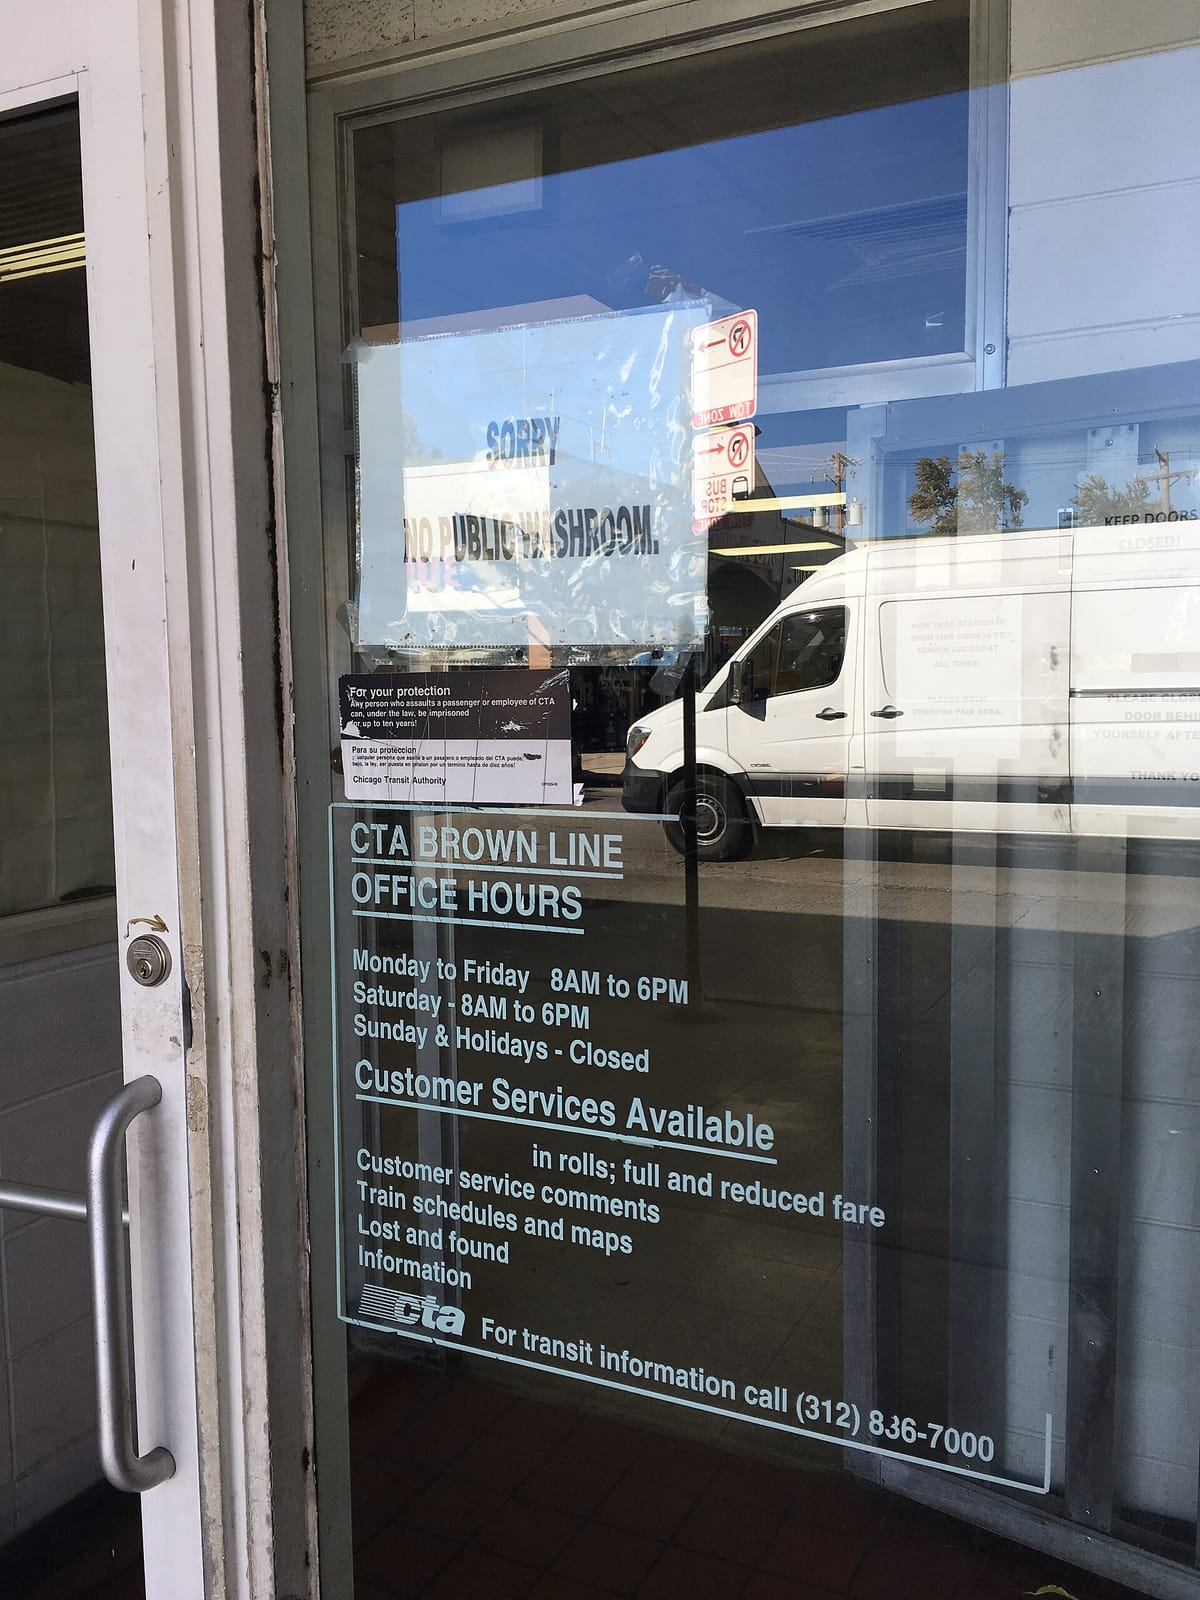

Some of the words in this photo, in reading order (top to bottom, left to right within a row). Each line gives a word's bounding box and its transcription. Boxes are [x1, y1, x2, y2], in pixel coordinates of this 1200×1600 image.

[486, 416, 561, 468] SORRY
[403, 518, 433, 563] NO
[439, 513, 515, 562] PUBLIC
[518, 504, 660, 561] WASHROOM.
[1104, 513, 1140, 526] KEEP
[1144, 508, 1198, 524] DOORS
[1118, 535, 1182, 551] CLOSED!
[350, 687, 367, 697] For
[370, 688, 394, 699] your
[397, 685, 451, 699] protection
[365, 701, 389, 709] person
[406, 699, 436, 707] assaults
[443, 700, 480, 708] passenger
[491, 698, 528, 707] employee
[529, 697, 537, 706] of
[538, 697, 556, 706] CTA
[402, 709, 416, 718] law,
[418, 709, 427, 717] be
[429, 709, 470, 718] imprisoned
[1161, 692, 1200, 703] CLOS
[396, 719, 418, 729] years!
[1124, 711, 1161, 721] DOOR
[1165, 711, 1200, 721] BEHI
[1166, 730, 1200, 741] AFTE
[352, 746, 367, 754] Para
[352, 775, 382, 785] Chicago
[384, 775, 410, 784] Transit
[412, 776, 447, 786] Authority
[1129, 770, 1177, 781] THANK
[1181, 772, 1200, 782] YO
[351, 822, 410, 857] CTA
[418, 826, 537, 864] BROWN
[549, 832, 624, 869] LINE
[352, 872, 458, 911] OFFICE
[468, 879, 583, 920] HOURS
[353, 949, 431, 983] Monday
[437, 961, 457, 980] to
[463, 959, 530, 994] Friday
[550, 967, 601, 996] 8AM
[607, 974, 630, 998] to
[637, 976, 689, 1005] 6PM
[353, 981, 442, 1018] Saturday
[461, 993, 507, 1021] 8AM
[513, 999, 536, 1025] to
[541, 1002, 590, 1030] 6PM
[353, 1013, 429, 1050] Sunday
[434, 1023, 450, 1048] &
[456, 1026, 548, 1064] Holidays
[568, 1039, 650, 1074] Closed
[354, 1058, 484, 1106] Customer
[491, 1077, 617, 1127] Services
[625, 1096, 775, 1151] Available
[356, 1148, 453, 1186] Customer
[459, 1169, 535, 1201] service
[541, 1184, 661, 1225] comments
[532, 1144, 552, 1170] in
[559, 1150, 616, 1185] rolls;
[623, 1158, 660, 1188] full
[667, 1172, 713, 1198] and
[720, 1180, 825, 1218] reduced
[832, 1194, 886, 1228] fare
[356, 1180, 406, 1211] Train
[412, 1195, 518, 1232] schedules
[524, 1216, 565, 1241] and
[571, 1223, 634, 1256] maps
[358, 1213, 401, 1242] Lost
[406, 1226, 443, 1251] and
[448, 1229, 510, 1265] found
[358, 1244, 473, 1290] Information
[393, 1294, 467, 1337] cta
[481, 1316, 517, 1347] For
[522, 1327, 594, 1367] transit
[600, 1343, 736, 1402] information
[744, 1384, 788, 1413] call
[796, 1391, 861, 1436] (312)
[868, 1408, 996, 1463] 836-7000
